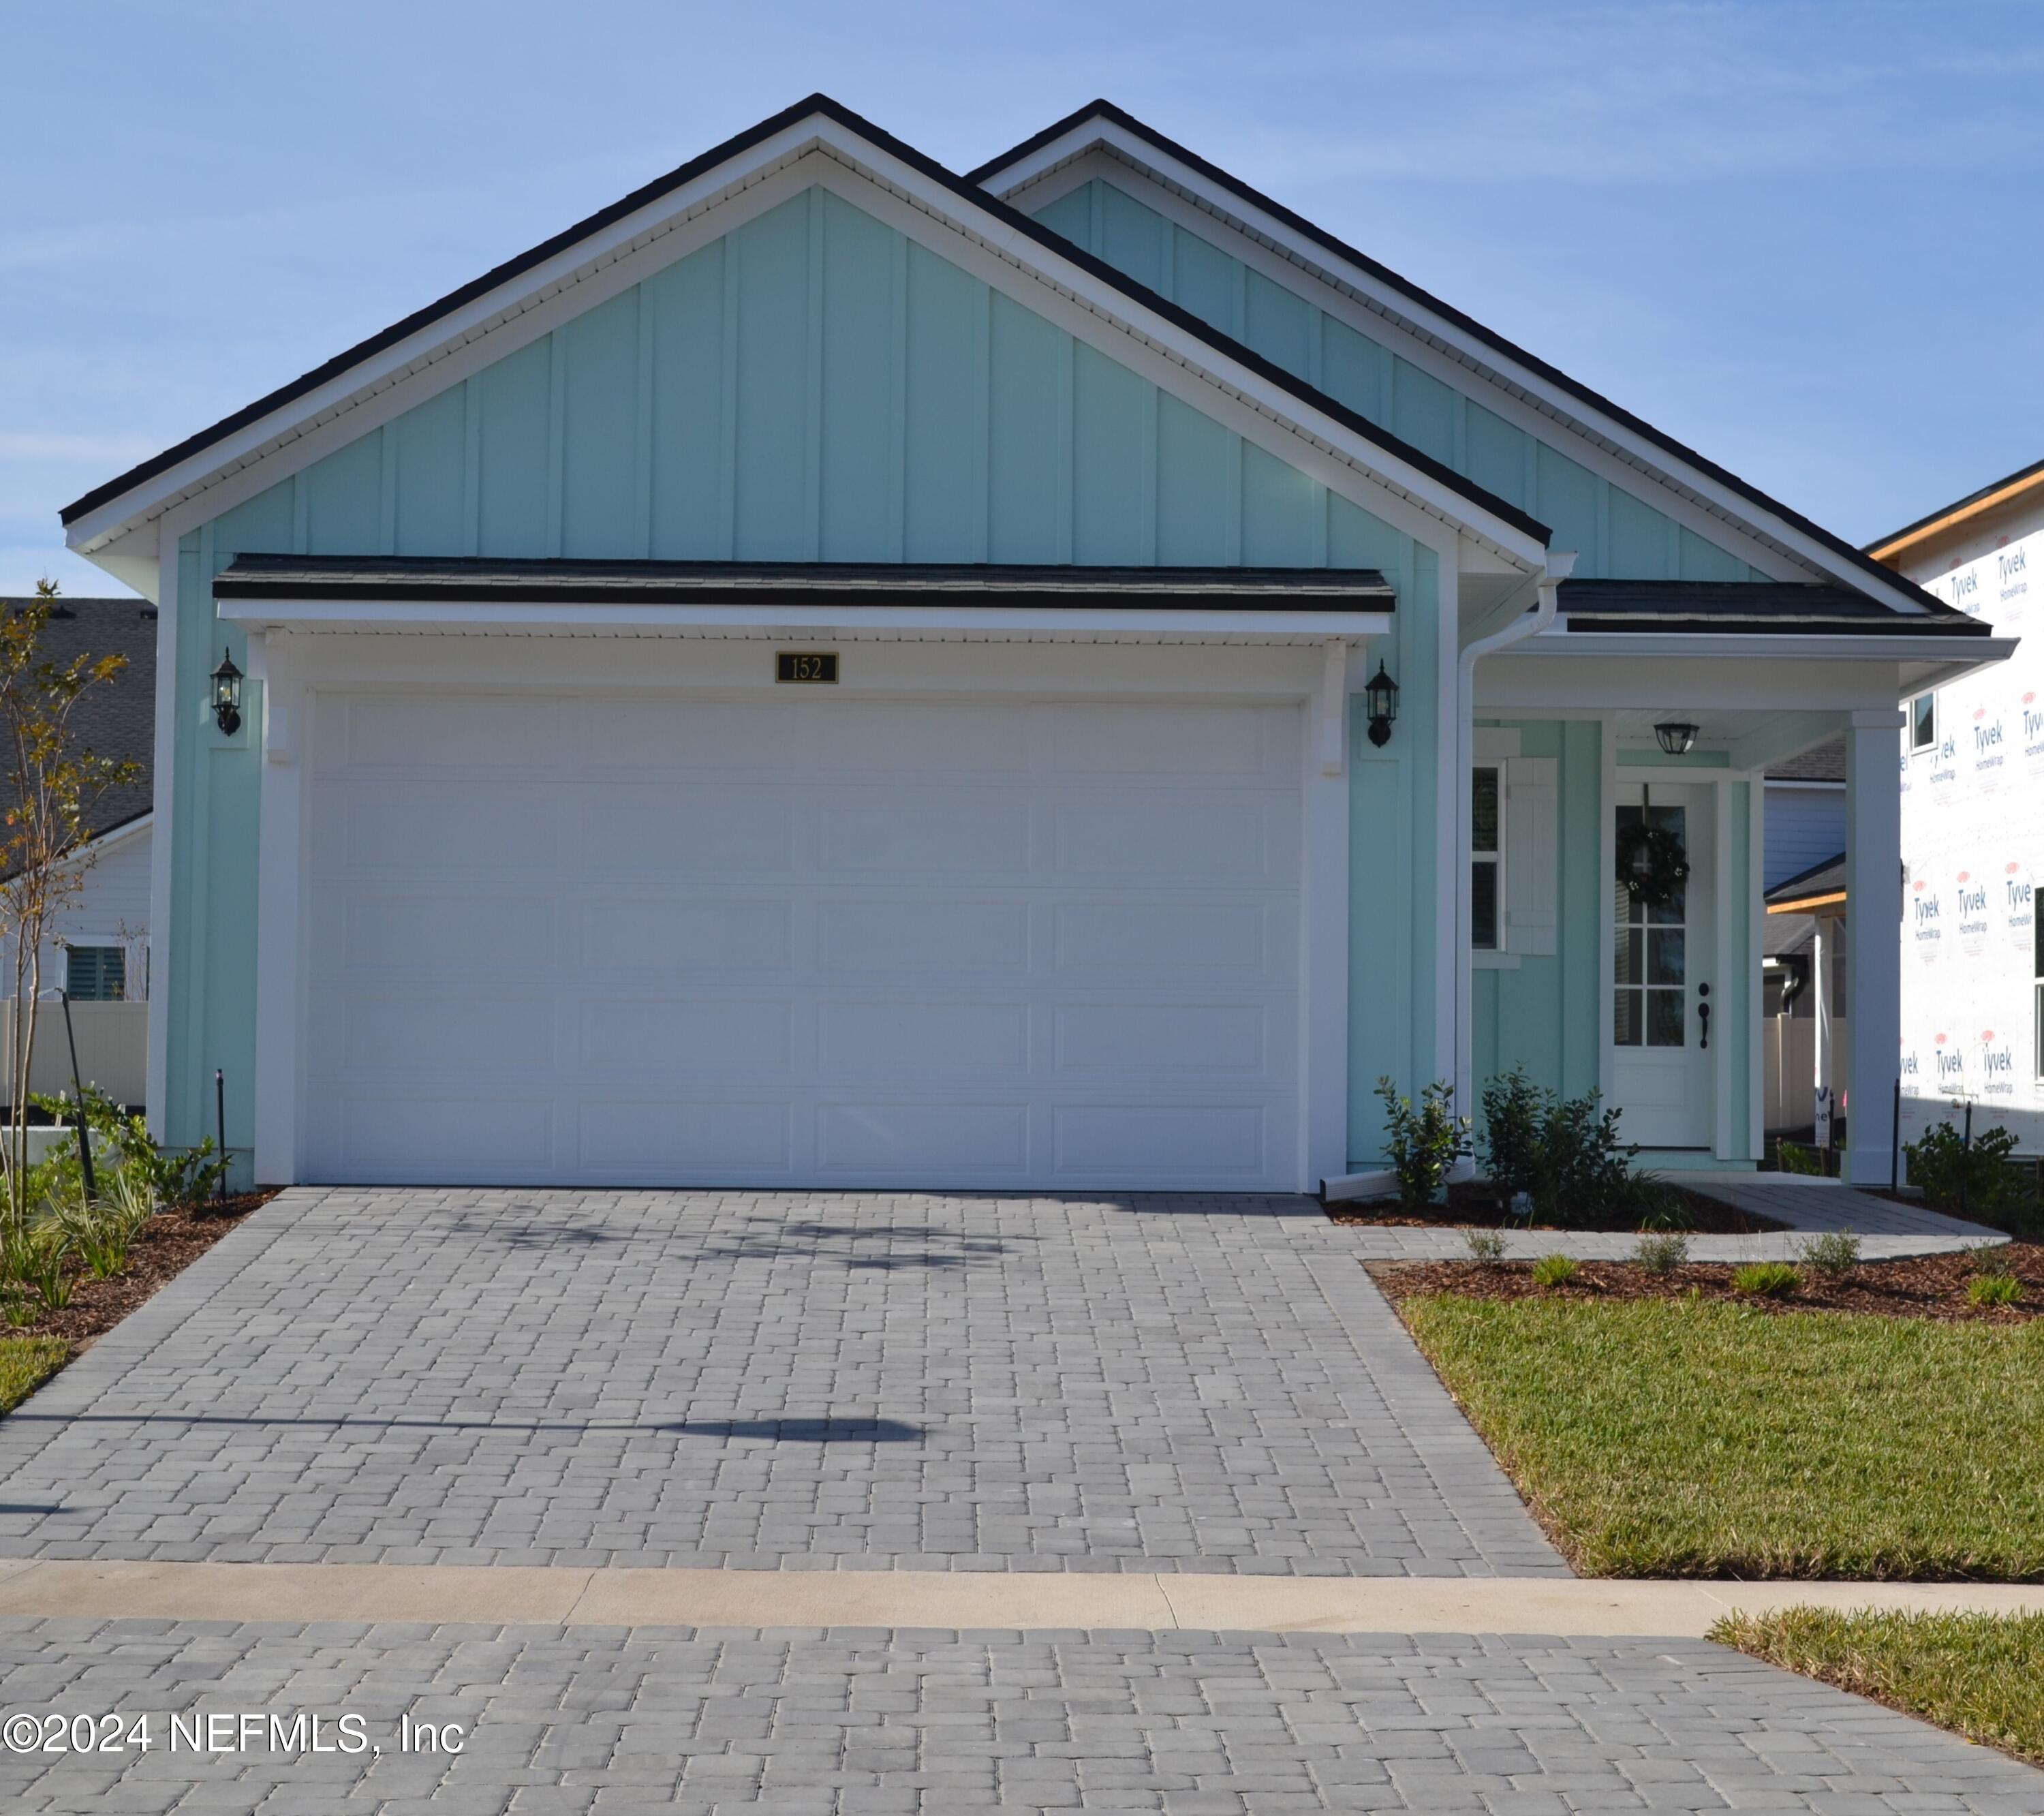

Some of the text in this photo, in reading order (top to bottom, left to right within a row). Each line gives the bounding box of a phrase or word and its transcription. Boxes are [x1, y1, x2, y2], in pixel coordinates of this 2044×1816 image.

[1998, 545, 2026, 585] Tyvek
[1951, 568, 1979, 604] Tyvek
[2000, 582, 2028, 602] HomeWrap
[792, 658, 821, 679] 152
[1974, 719, 2002, 755] Tyvek
[2023, 710, 2044, 741] Tyv
[1975, 755, 2004, 771] HomeWrap
[1929, 769, 1956, 784] HomeWrap
[1914, 893, 1940, 927] Tyvek
[1958, 885, 1987, 919] Tyvek
[1915, 927, 1940, 941] HomeWrap
[1959, 920, 1987, 935] HomeWrap
[1936, 1048, 1963, 1080] Tyvek
[1984, 1081, 2013, 1096] HomeWrap
